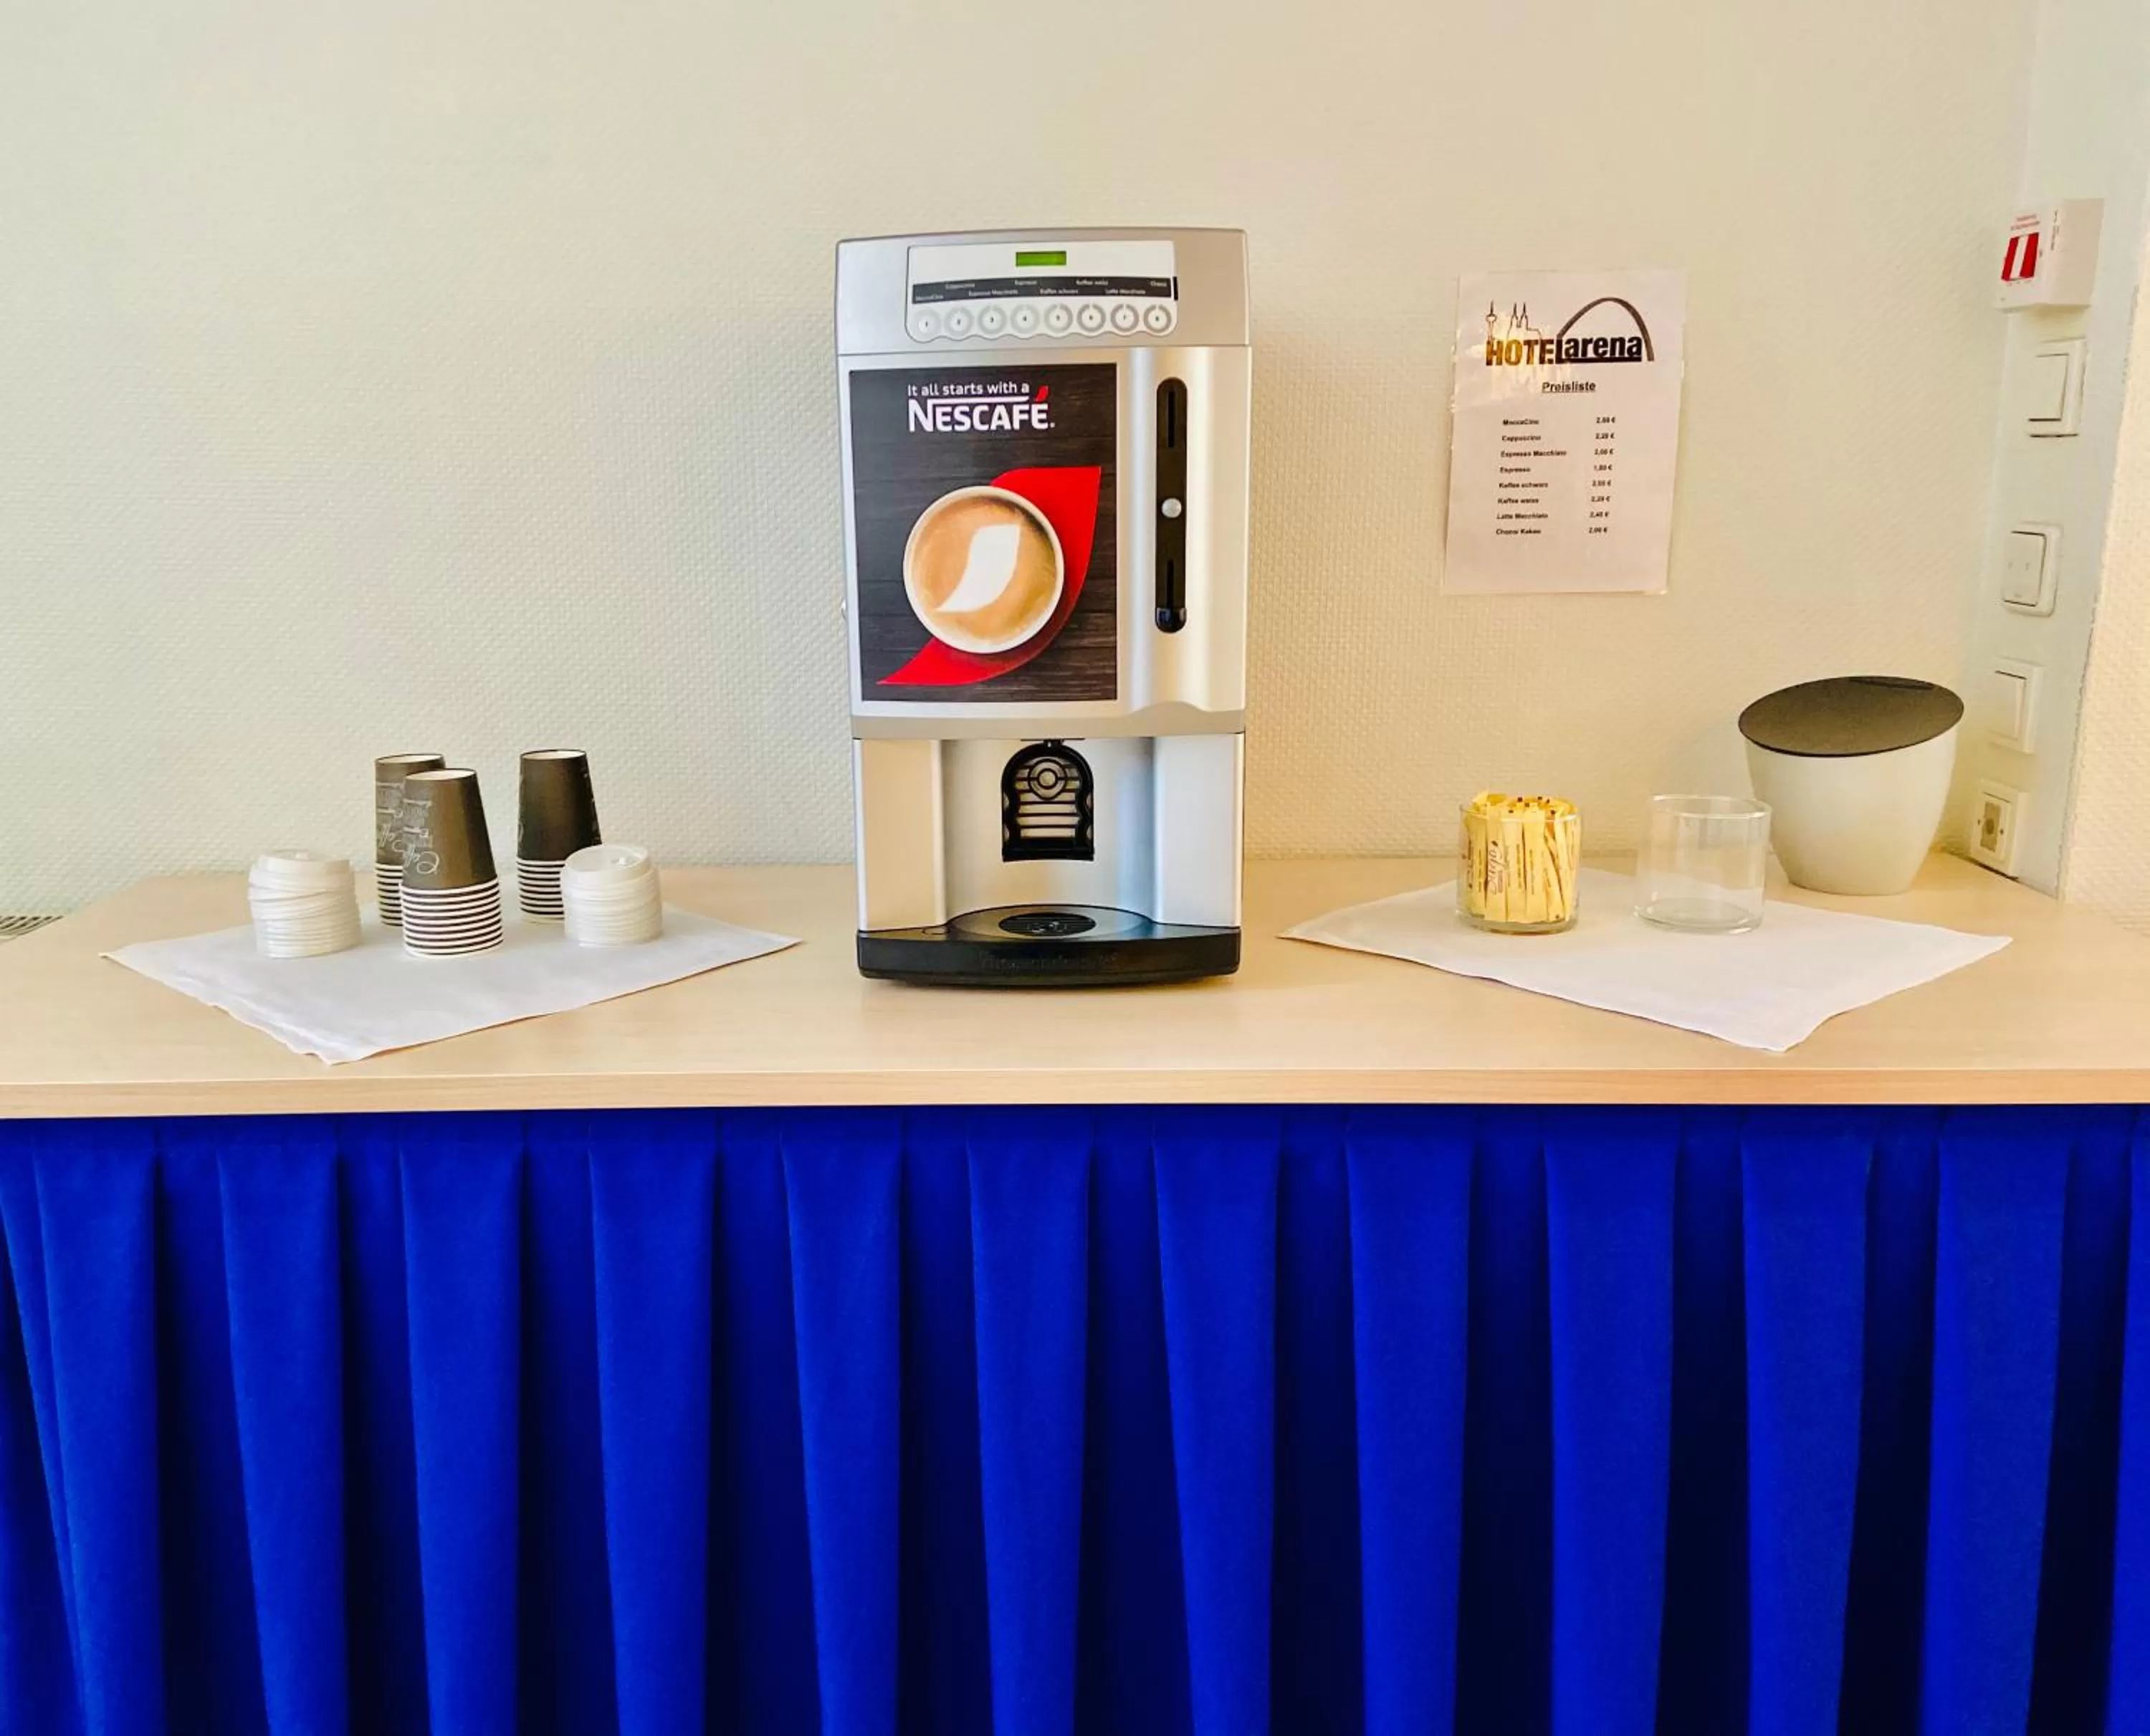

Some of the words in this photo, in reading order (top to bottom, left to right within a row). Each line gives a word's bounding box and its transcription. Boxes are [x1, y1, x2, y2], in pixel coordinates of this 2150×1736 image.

[907, 383, 918, 396] It
[921, 383, 939, 396] all
[942, 382, 983, 396] starts
[987, 381, 1018, 394] with
[1021, 382, 1030, 394] a
[1542, 381, 1597, 393] Preisliste
